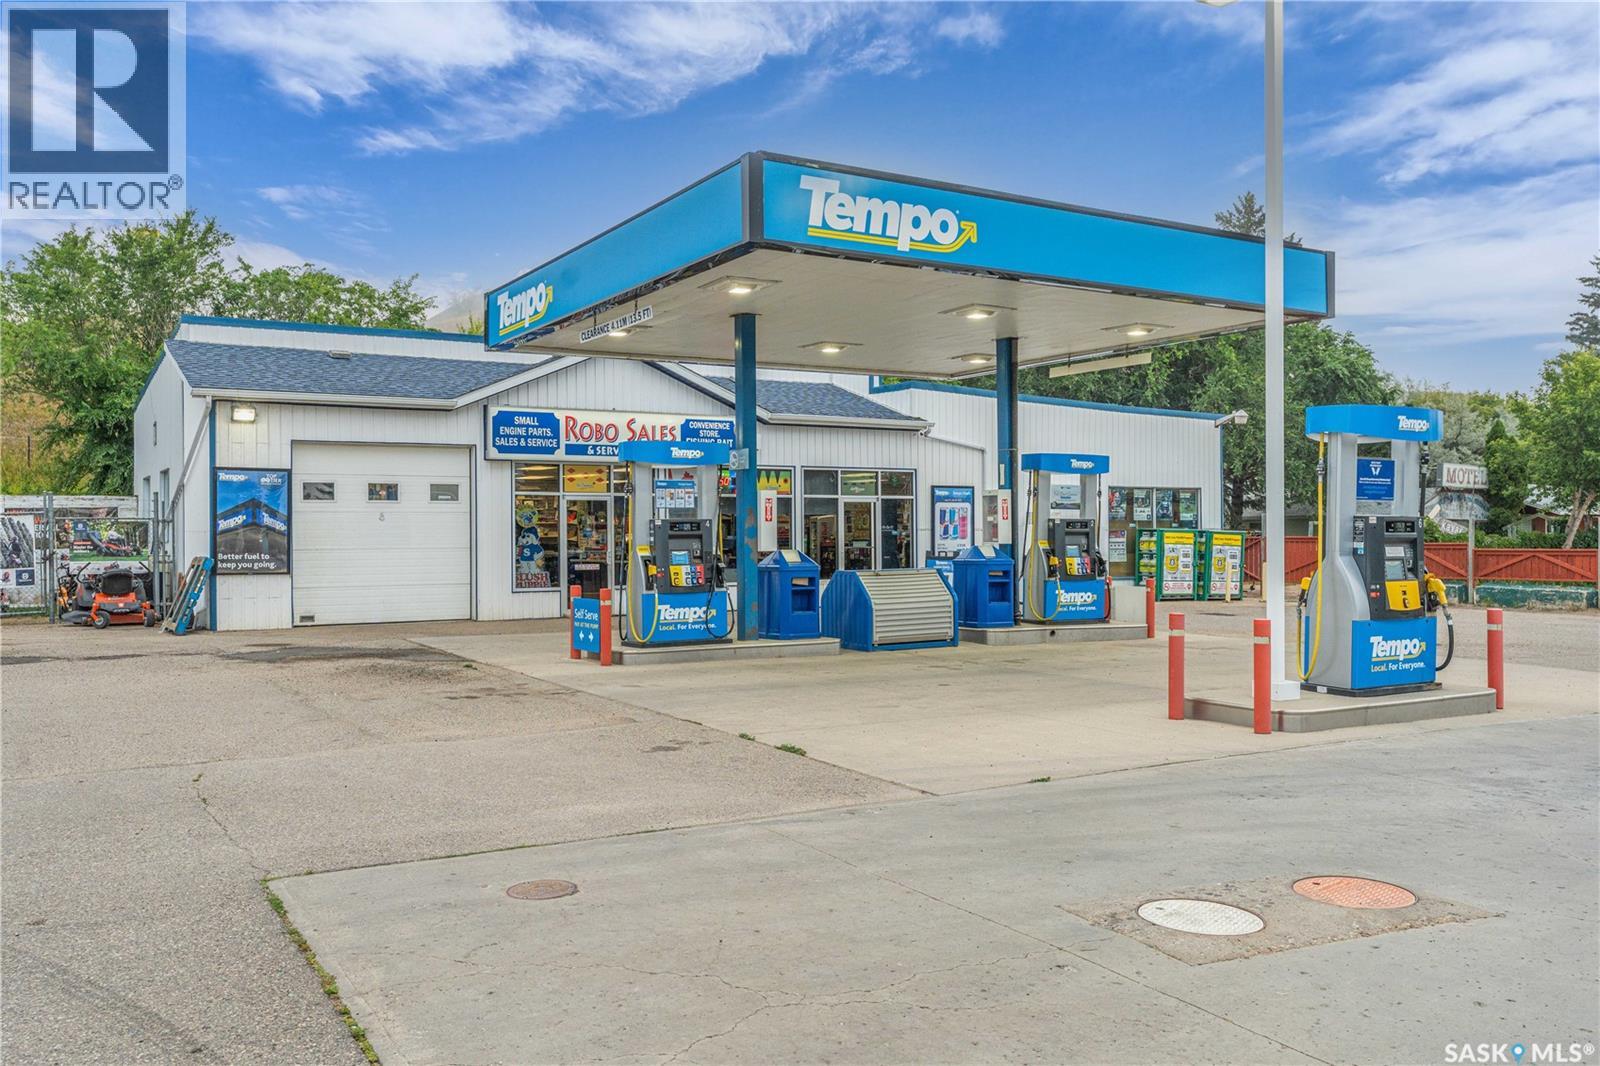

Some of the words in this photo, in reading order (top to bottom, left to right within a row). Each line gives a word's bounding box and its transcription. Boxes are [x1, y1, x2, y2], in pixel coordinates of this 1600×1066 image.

[800, 175, 959, 252] Tempo
[498, 282, 547, 328] Tempo
[581, 324, 610, 341] CLEARANCE
[611, 316, 627, 329] 4.11M
[514, 416, 538, 425] SMALL
[689, 421, 731, 430] CONVENIENCE
[1397, 415, 1426, 432] Tempo
[499, 427, 526, 436] ENGINE
[495, 437, 518, 446] SALES
[520, 438, 526, 446] &
[527, 439, 557, 448] SERVICE
[587, 446, 595, 455] &
[670, 447, 702, 459] Tempo
[1070, 458, 1093, 469] Tempo
[219, 473, 246, 481] Tempo
[1446, 467, 1488, 485] MOTEL
[218, 561, 236, 569] keep
[237, 562, 252, 570] you
[253, 561, 277, 569] going.
[1056, 589, 1092, 605] Tempo
[574, 608, 585, 619] Self
[585, 610, 598, 621] Serve
[658, 605, 709, 622] Tempo
[1370, 636, 1420, 660] Tempo
[1371, 664, 1388, 673] Local.
[1388, 663, 1398, 671] For
[1398, 661, 1426, 671] Everyone.
